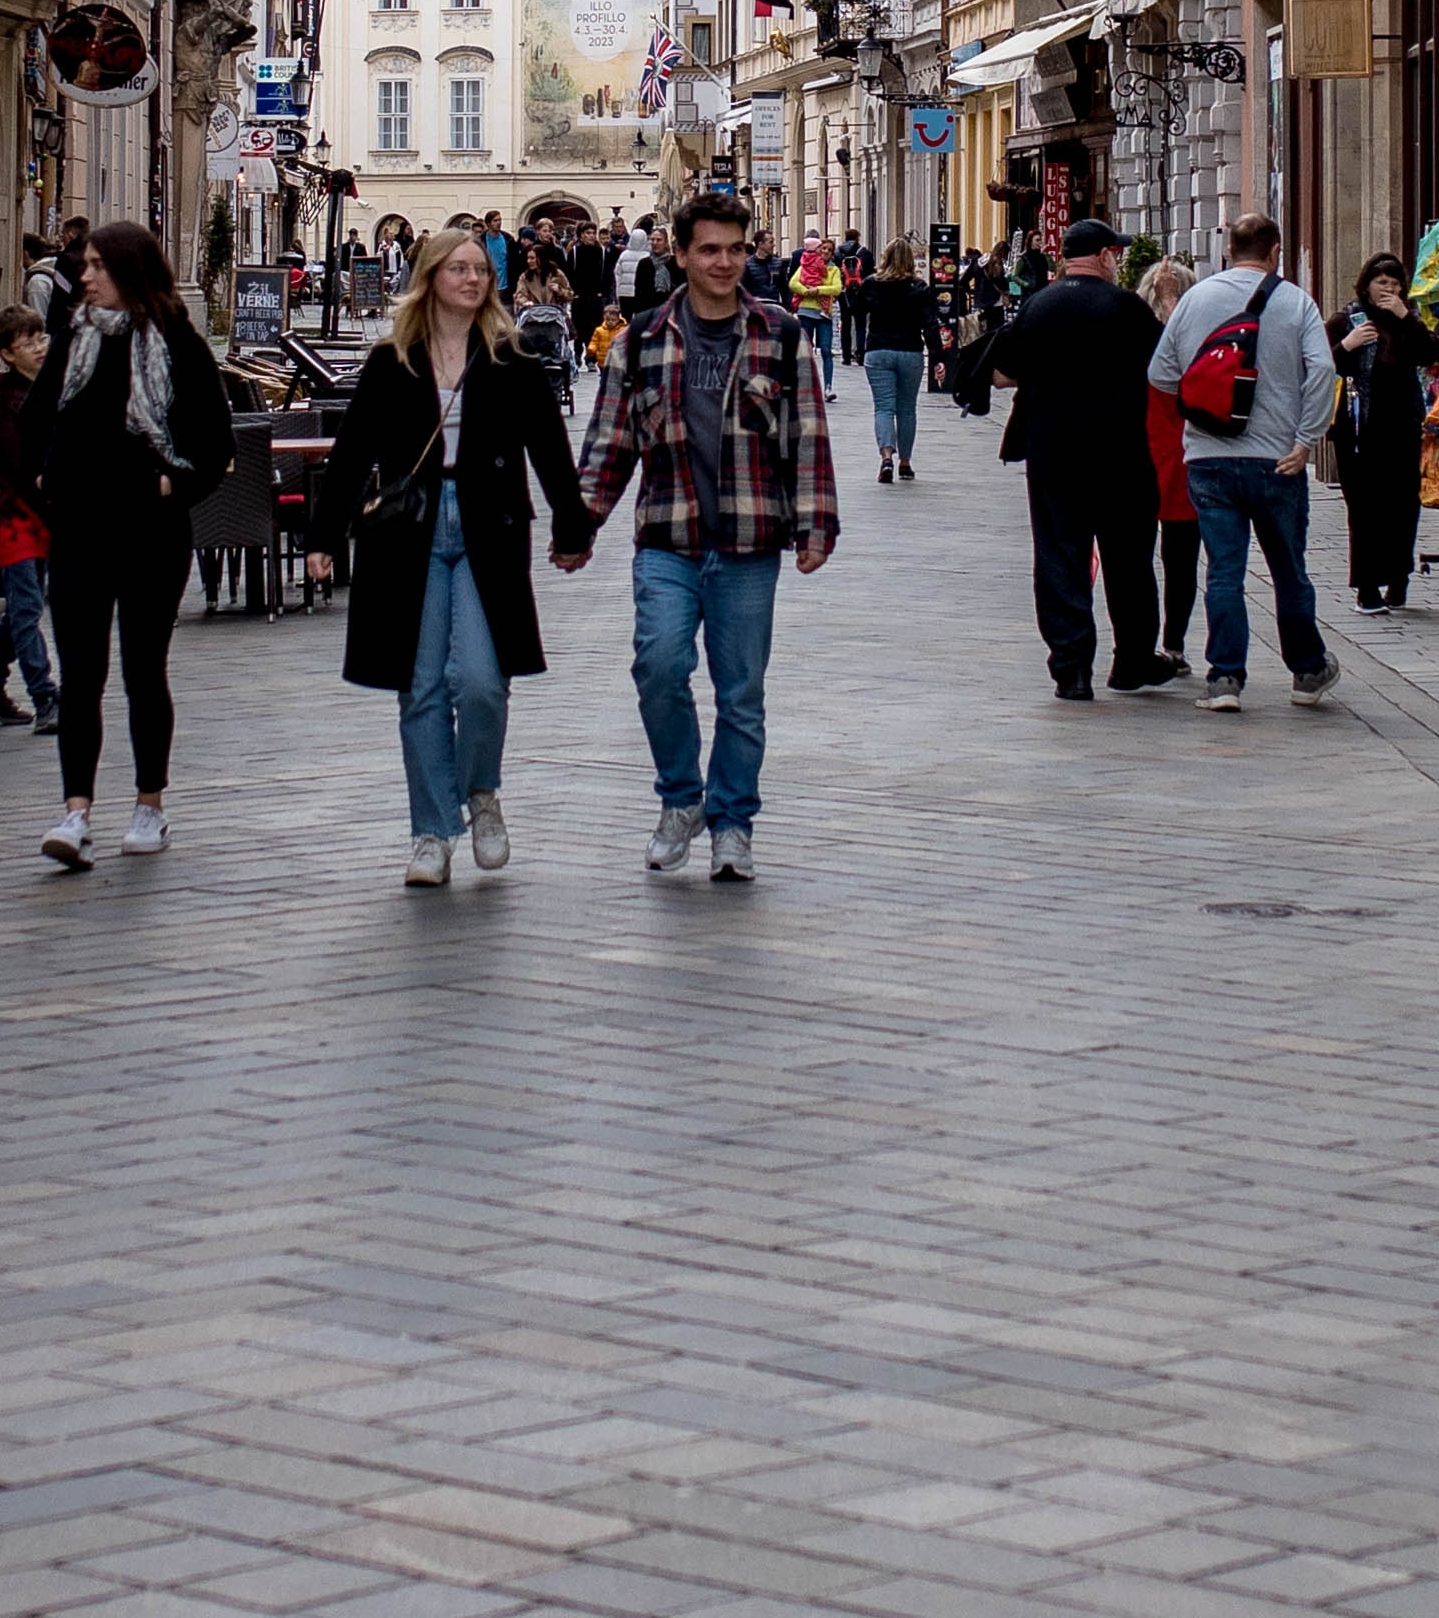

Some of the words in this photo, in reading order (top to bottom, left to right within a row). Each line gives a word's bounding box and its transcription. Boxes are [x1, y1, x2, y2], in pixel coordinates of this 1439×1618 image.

[589, 1, 612, 11] ILLO
[576, 13, 626, 23] PROFILLO
[588, 37, 614, 47] 2023
[713, 162, 732, 171] TESLA
[1046, 167, 1057, 262] LUGGA
[237, 292, 280, 308] VERNE
[235, 308, 254, 318] CRAFT
[255, 309, 270, 319] BEER
[271, 309, 284, 320] PUB
[246, 321, 267, 331] BEERS
